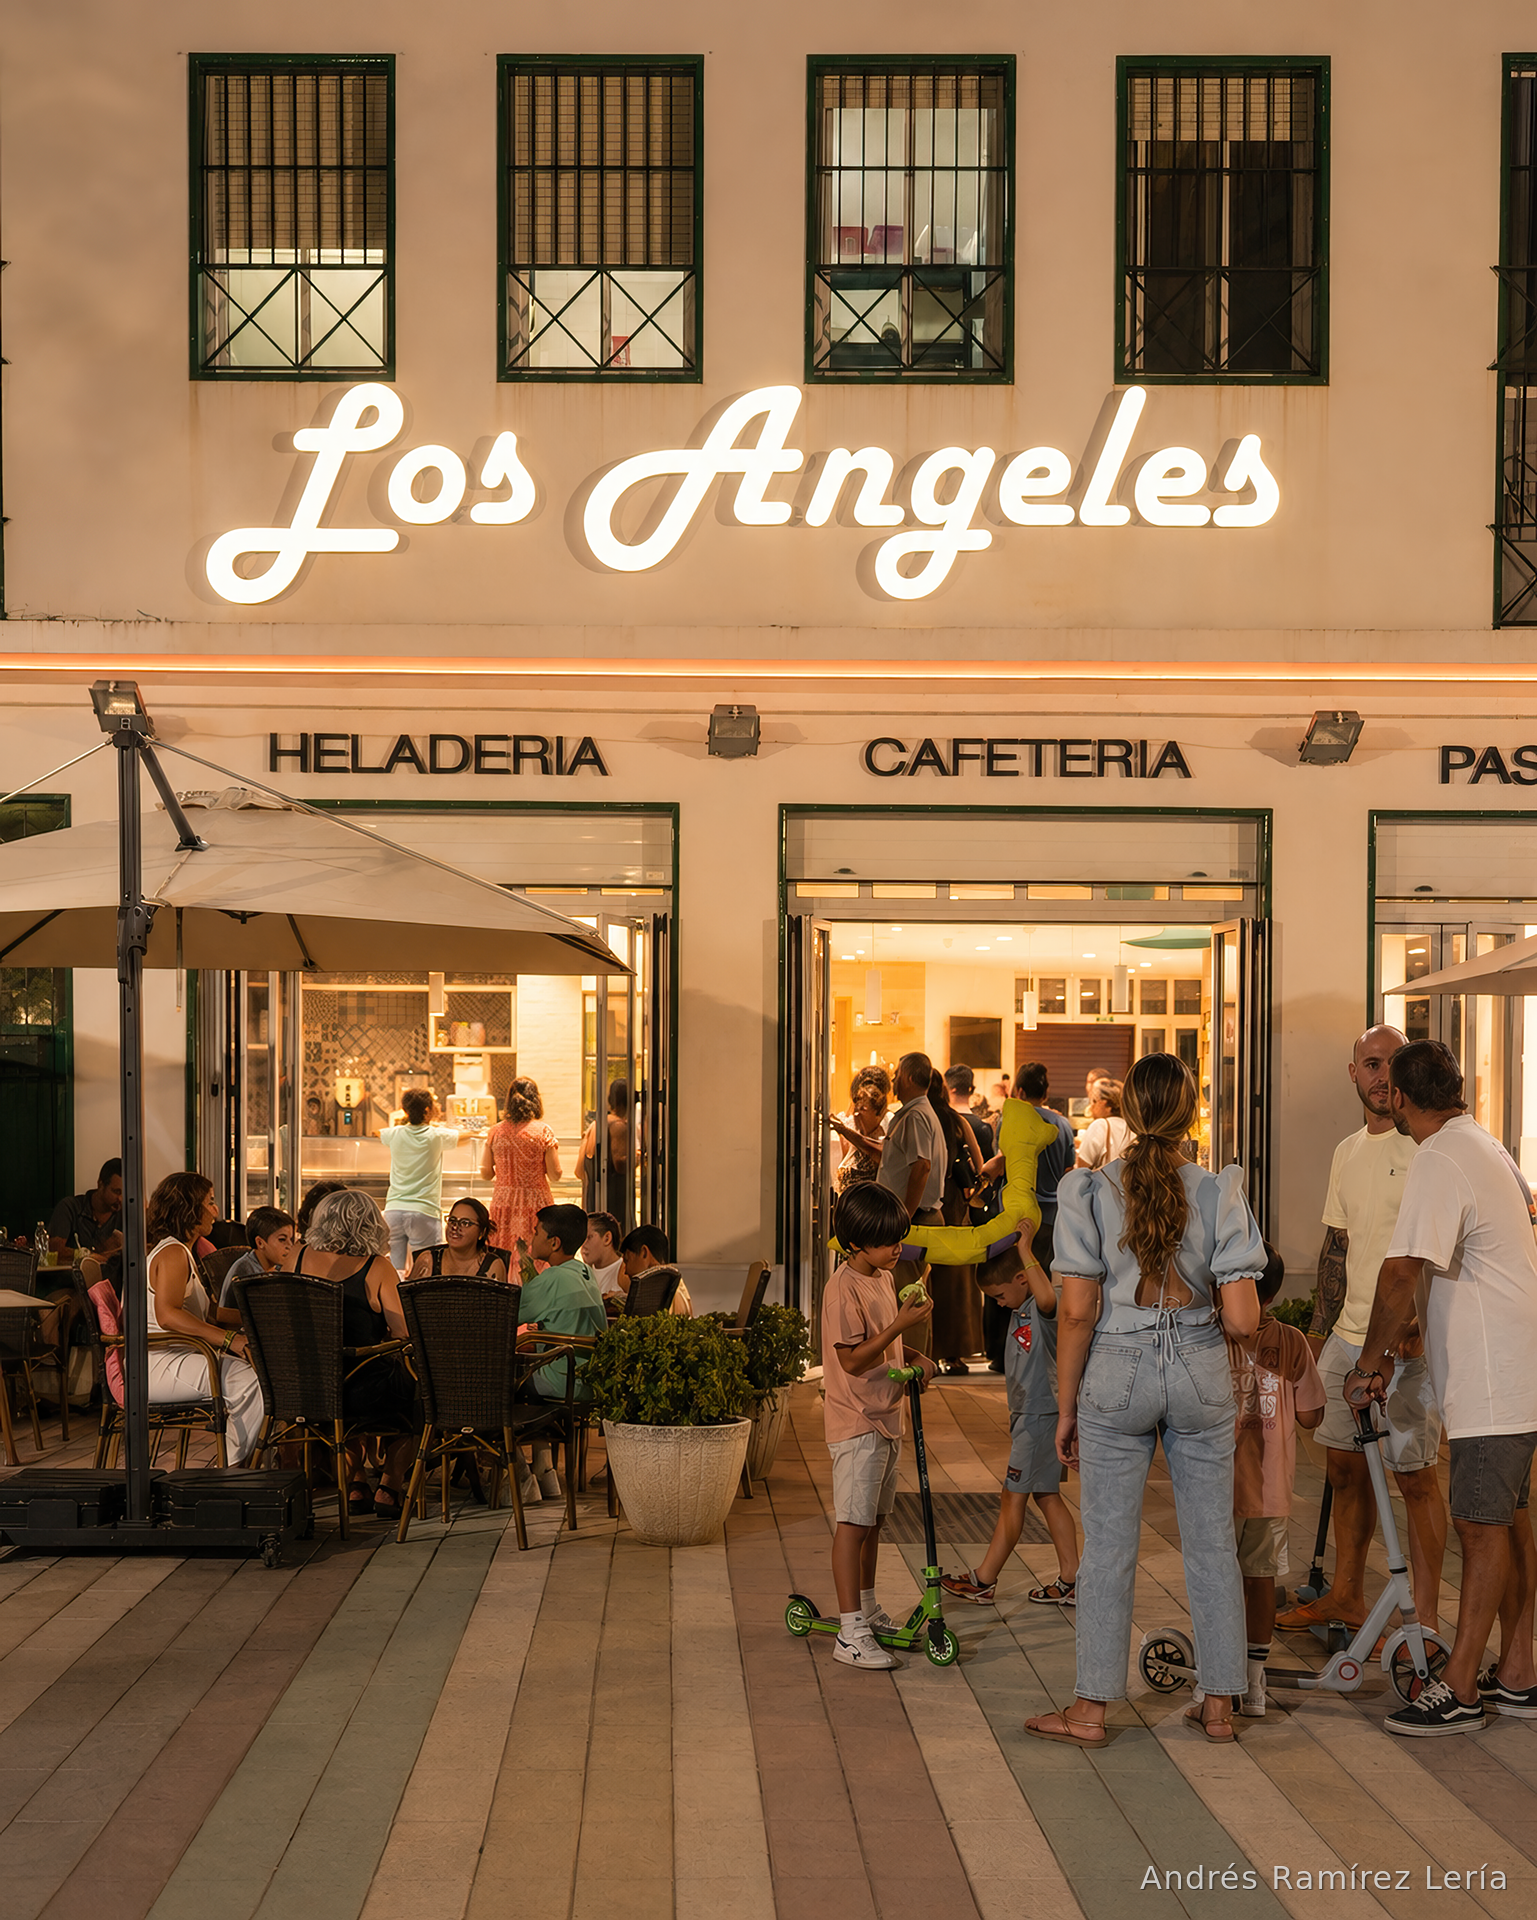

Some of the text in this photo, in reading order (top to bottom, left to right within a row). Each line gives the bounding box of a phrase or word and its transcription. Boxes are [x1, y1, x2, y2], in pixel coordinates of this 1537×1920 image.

[205, 382, 1281, 604] Los Angeles
[268, 732, 608, 776] HELADERIA
[865, 737, 1191, 778] CAFETERIA
[1440, 745, 1537, 785] PAS
